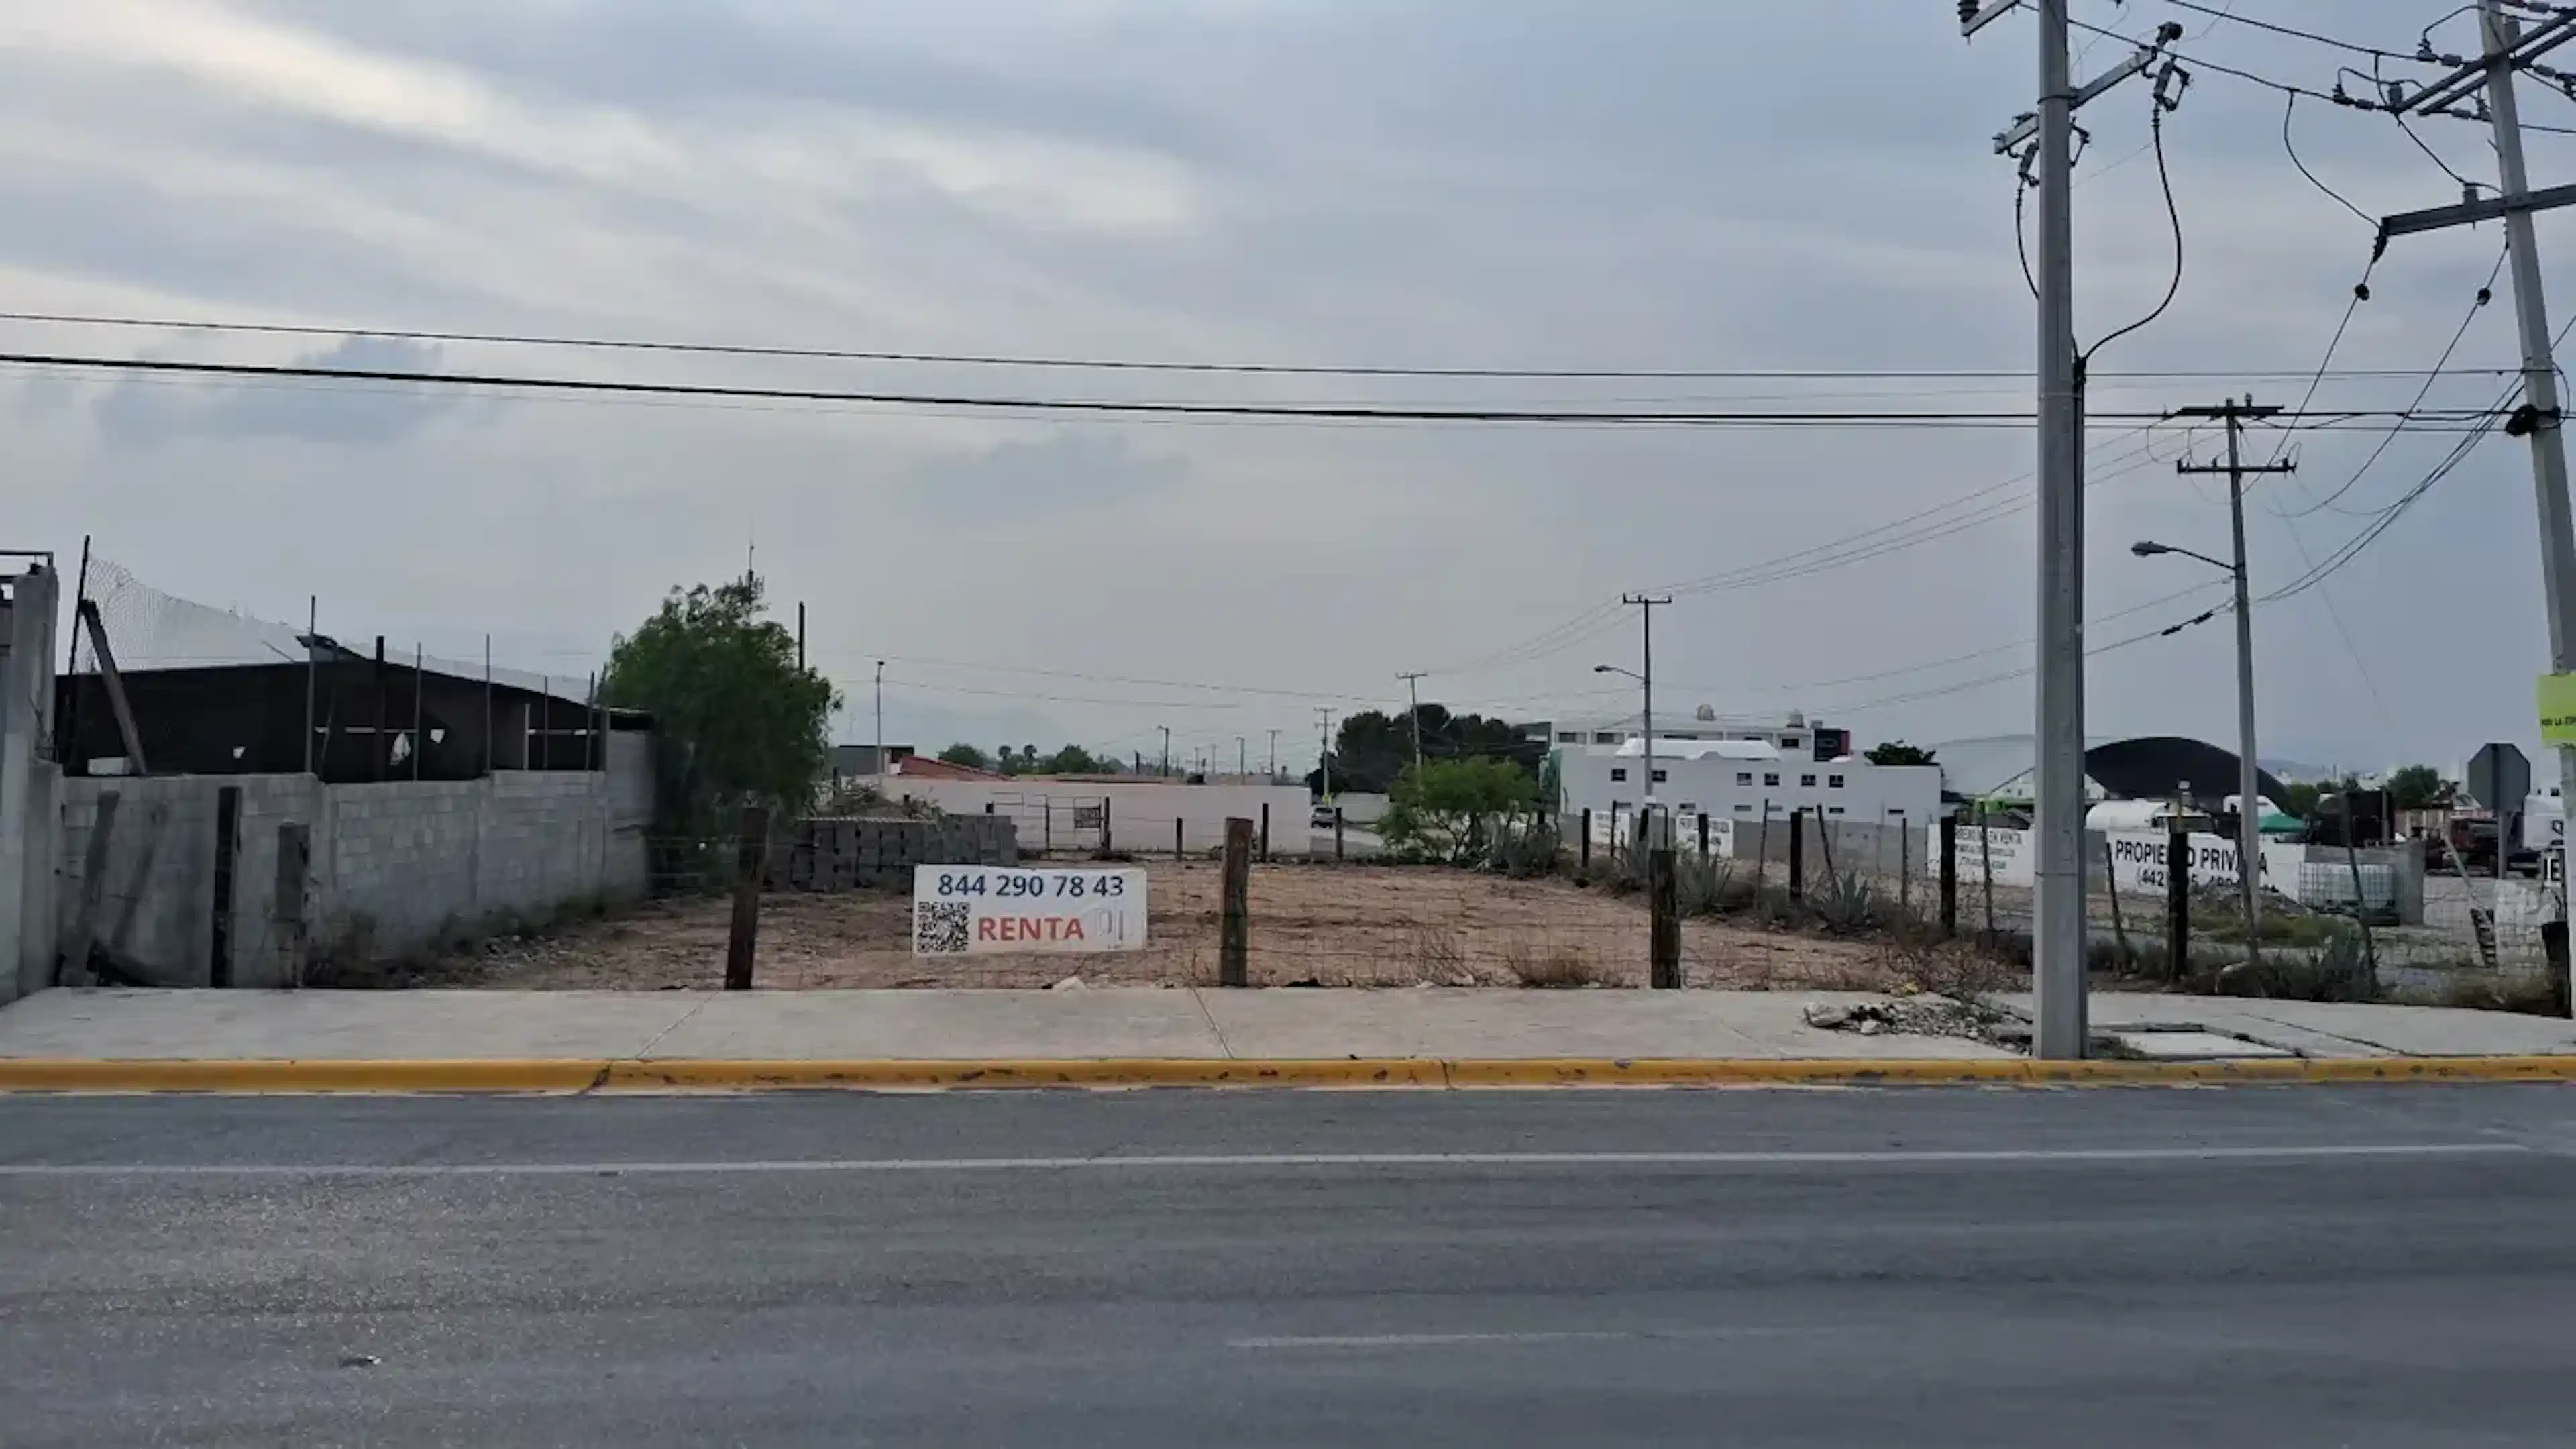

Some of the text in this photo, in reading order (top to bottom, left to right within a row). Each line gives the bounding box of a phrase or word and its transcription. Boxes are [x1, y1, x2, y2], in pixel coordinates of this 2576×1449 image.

[2116, 840, 2268, 877] PROPIED PRIVA
[938, 874, 1124, 897] 844 290 78 43
[979, 917, 1085, 941] RENTA
